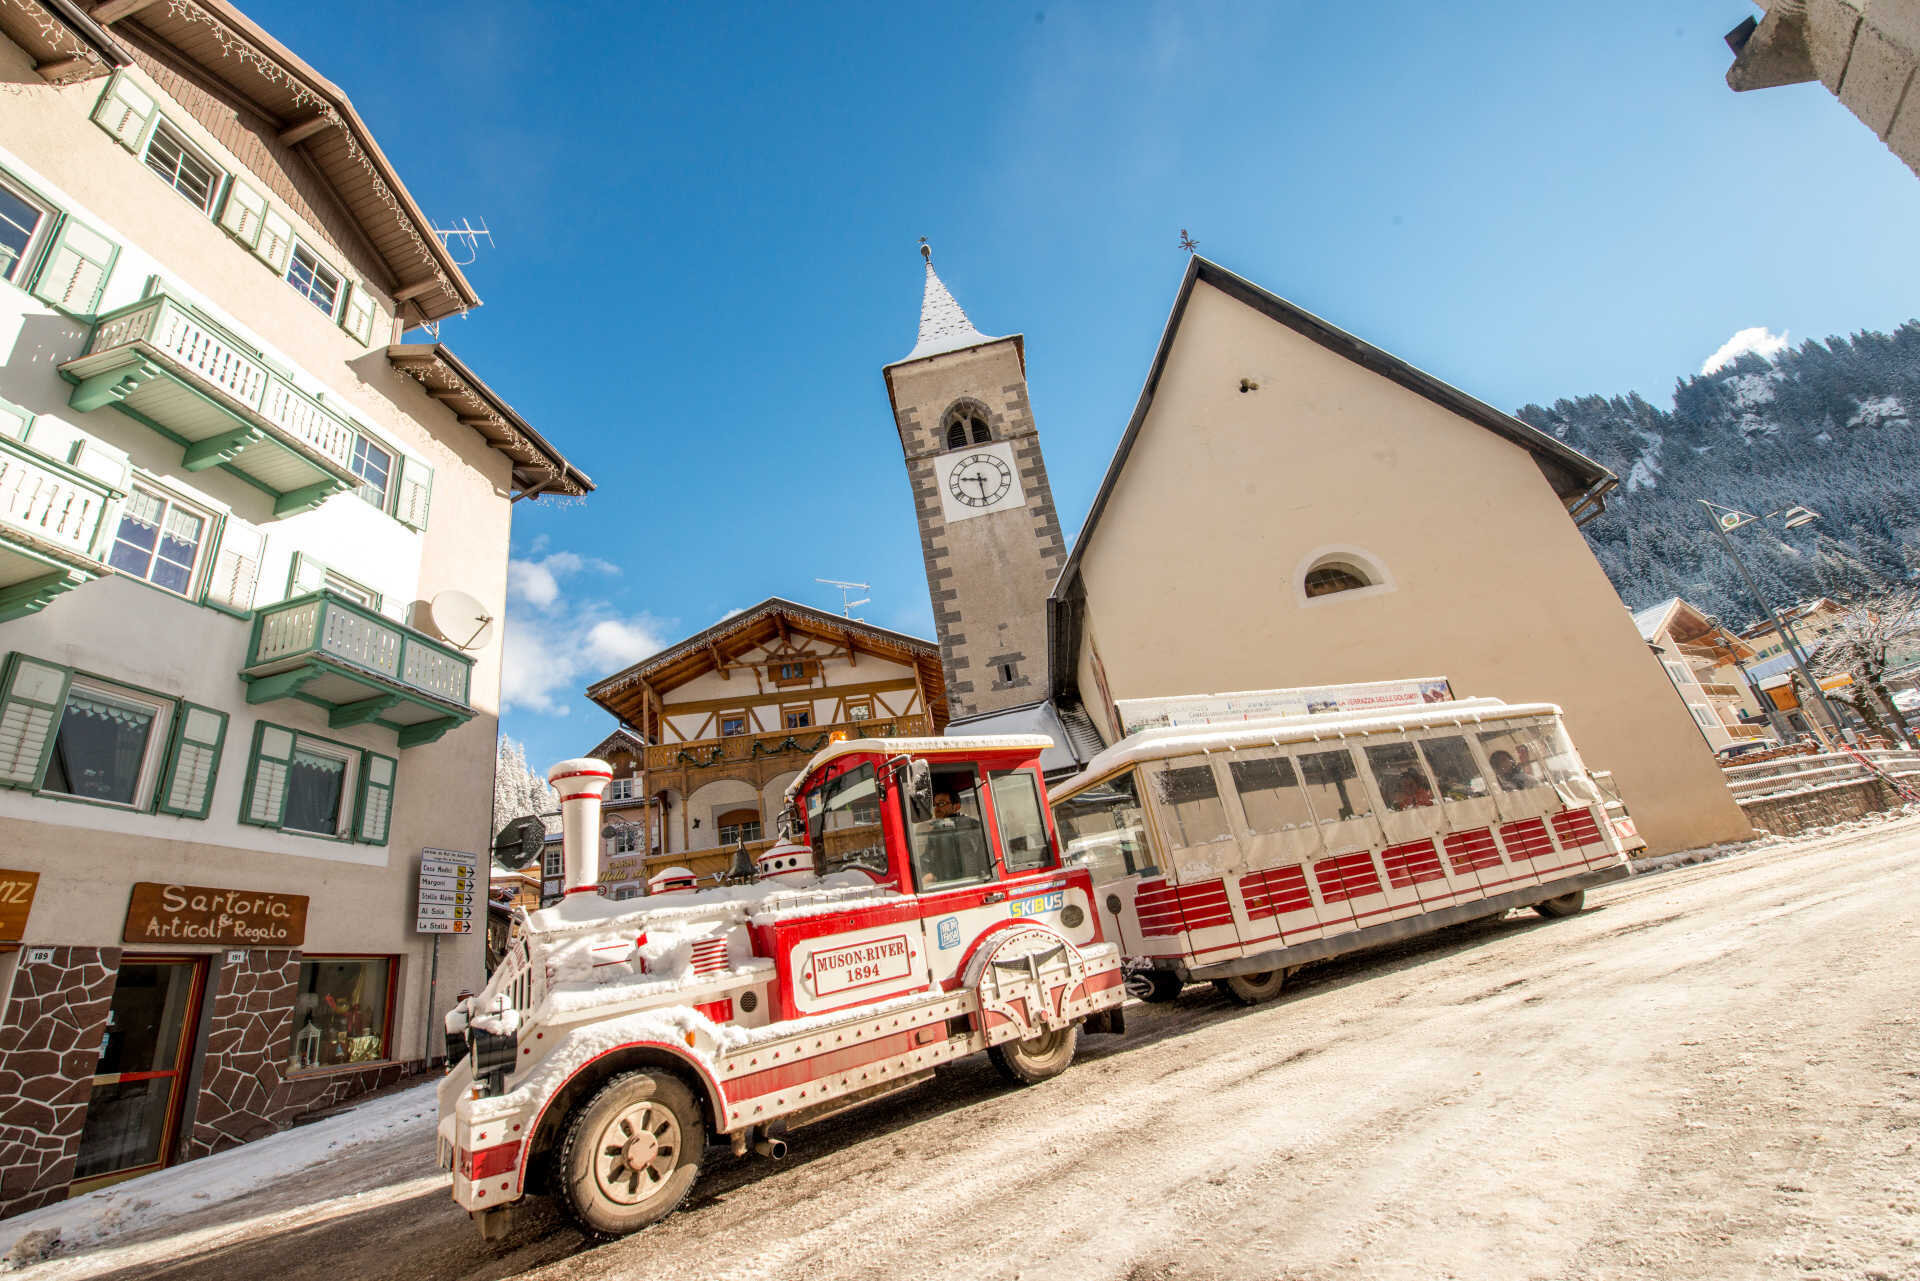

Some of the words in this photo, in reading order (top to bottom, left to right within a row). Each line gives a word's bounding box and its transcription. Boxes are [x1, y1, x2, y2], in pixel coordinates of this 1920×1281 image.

[162, 885, 290, 918] Sartoria
[1011, 893, 1063, 918] SKIBUS
[145, 915, 222, 939] Articoli
[218, 913, 233, 928] &
[233, 920, 287, 943] Regalo
[34, 952, 49, 961] 189
[847, 962, 881, 983] 1894
